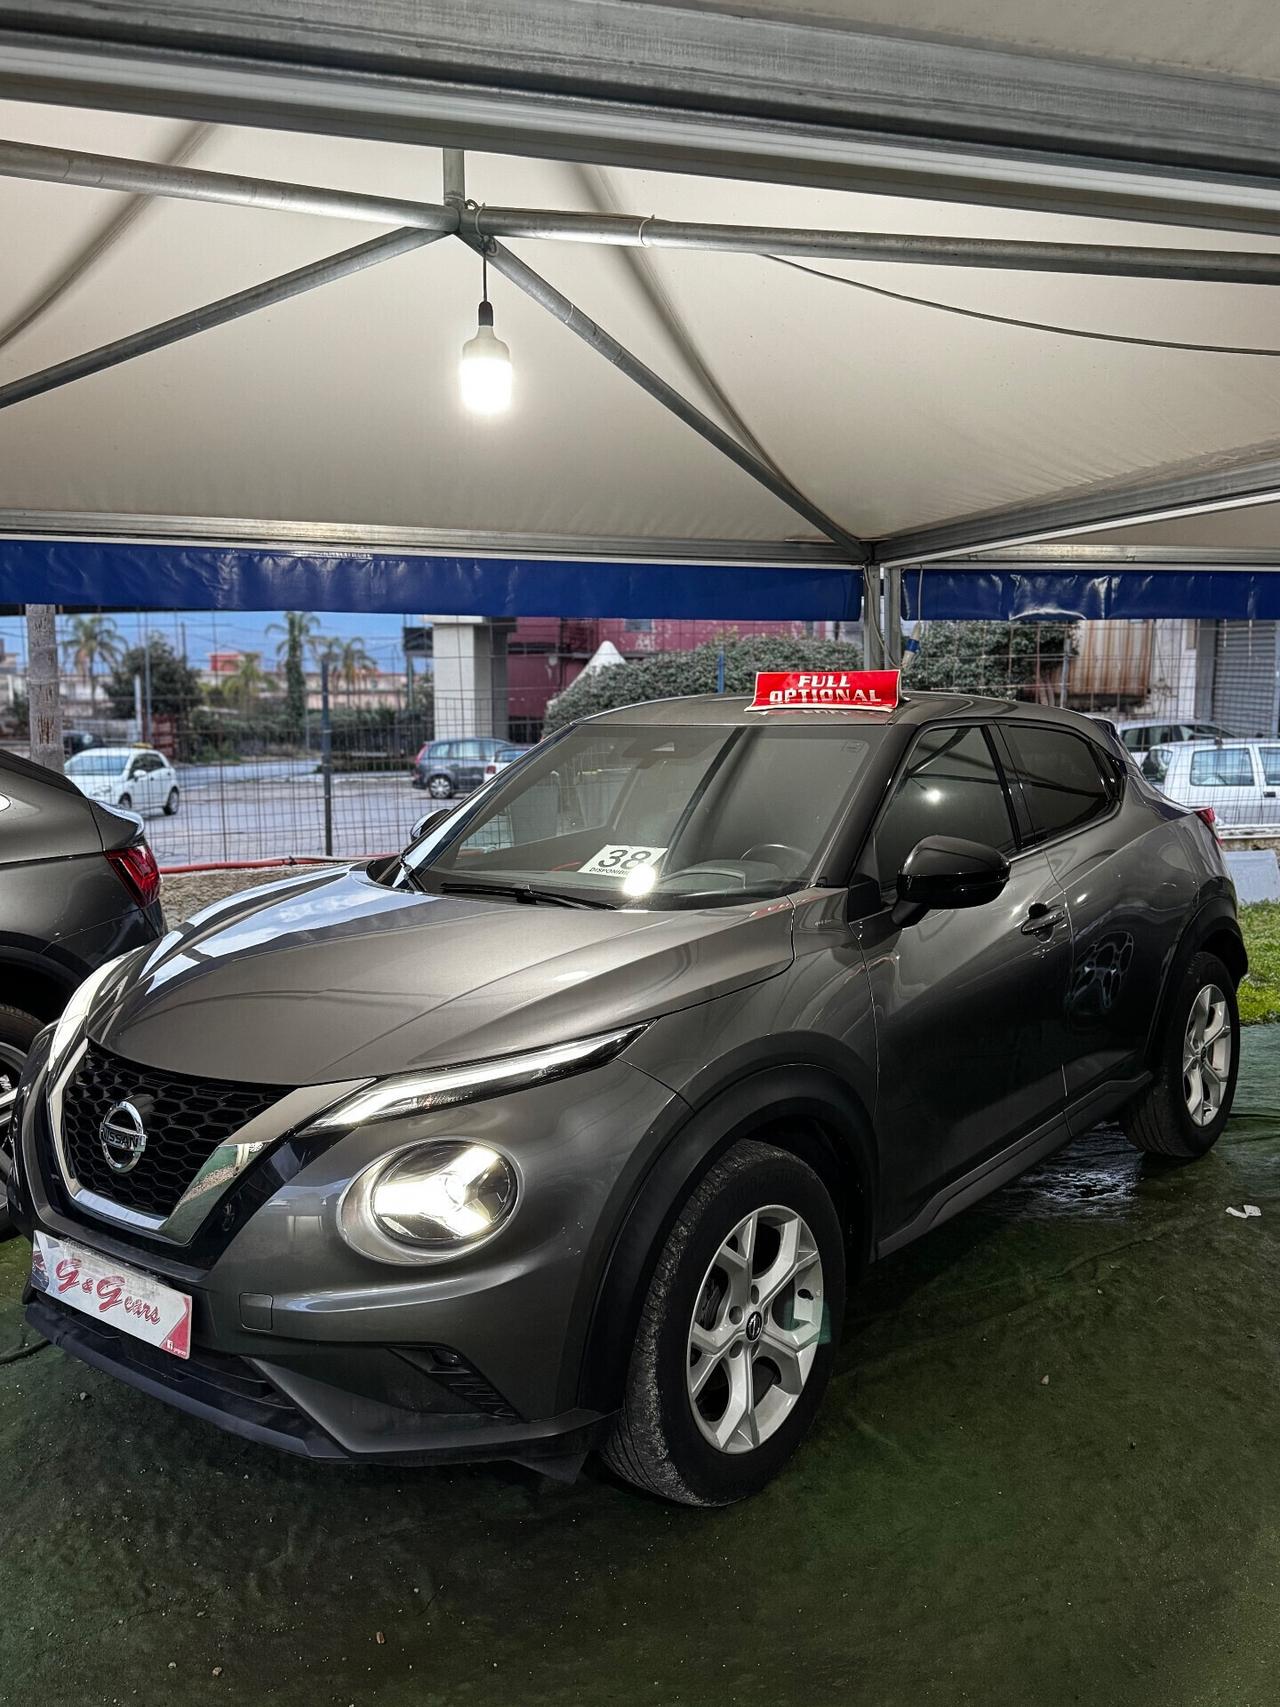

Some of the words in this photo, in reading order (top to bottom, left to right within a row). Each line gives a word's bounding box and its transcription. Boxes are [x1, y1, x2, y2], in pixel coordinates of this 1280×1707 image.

[798, 675, 850, 688] FULL
[769, 689, 881, 703] OPTIONAL
[598, 850, 651, 869] 38
[102, 1127, 140, 1149] NISSAN
